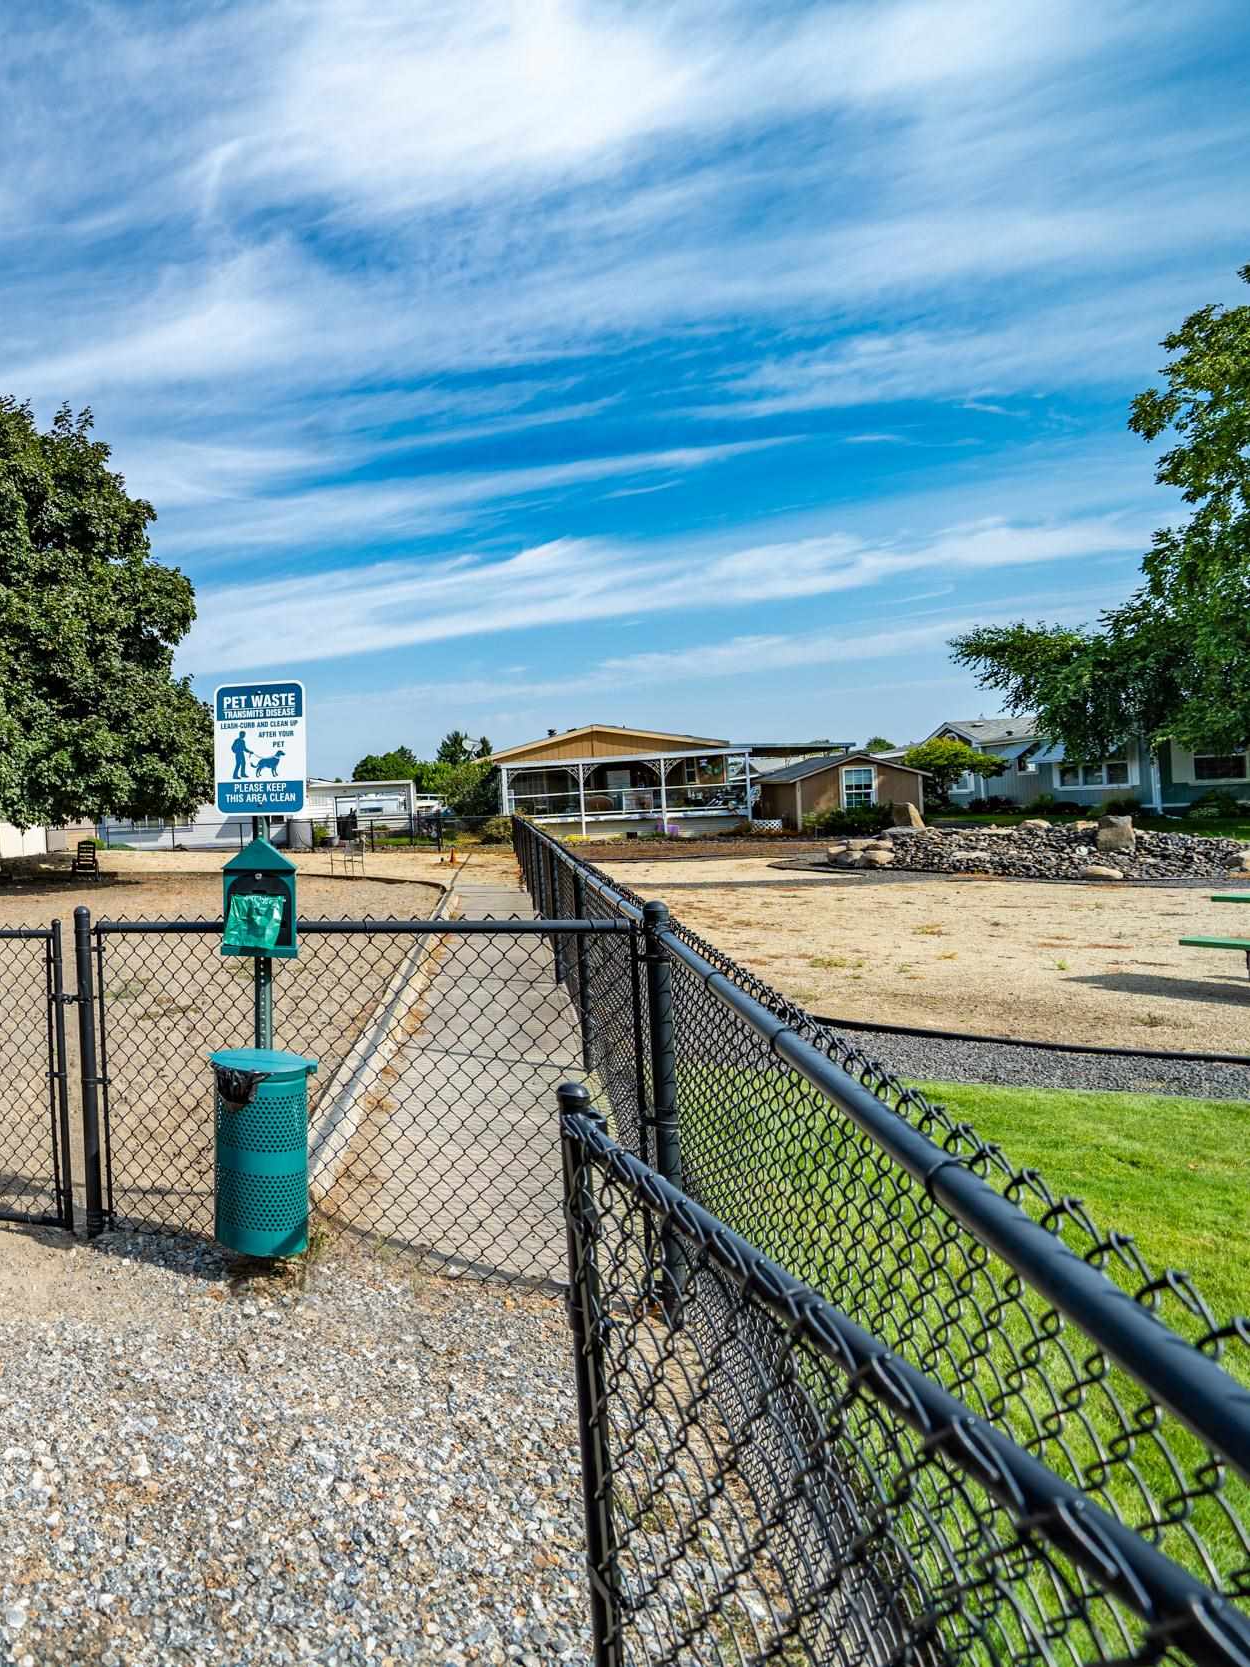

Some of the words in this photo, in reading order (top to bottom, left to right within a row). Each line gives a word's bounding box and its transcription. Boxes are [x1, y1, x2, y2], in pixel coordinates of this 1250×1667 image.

[223, 696, 247, 709] PET
[251, 693, 296, 708] WASTE
[223, 709, 264, 719] TRANSMITS
[266, 708, 296, 717] DISEASE
[234, 783, 264, 793] PLEASE
[266, 782, 286, 792] KEEP
[225, 794, 244, 803] THIS
[246, 793, 267, 802] AREA
[269, 792, 296, 802] CLEAN
